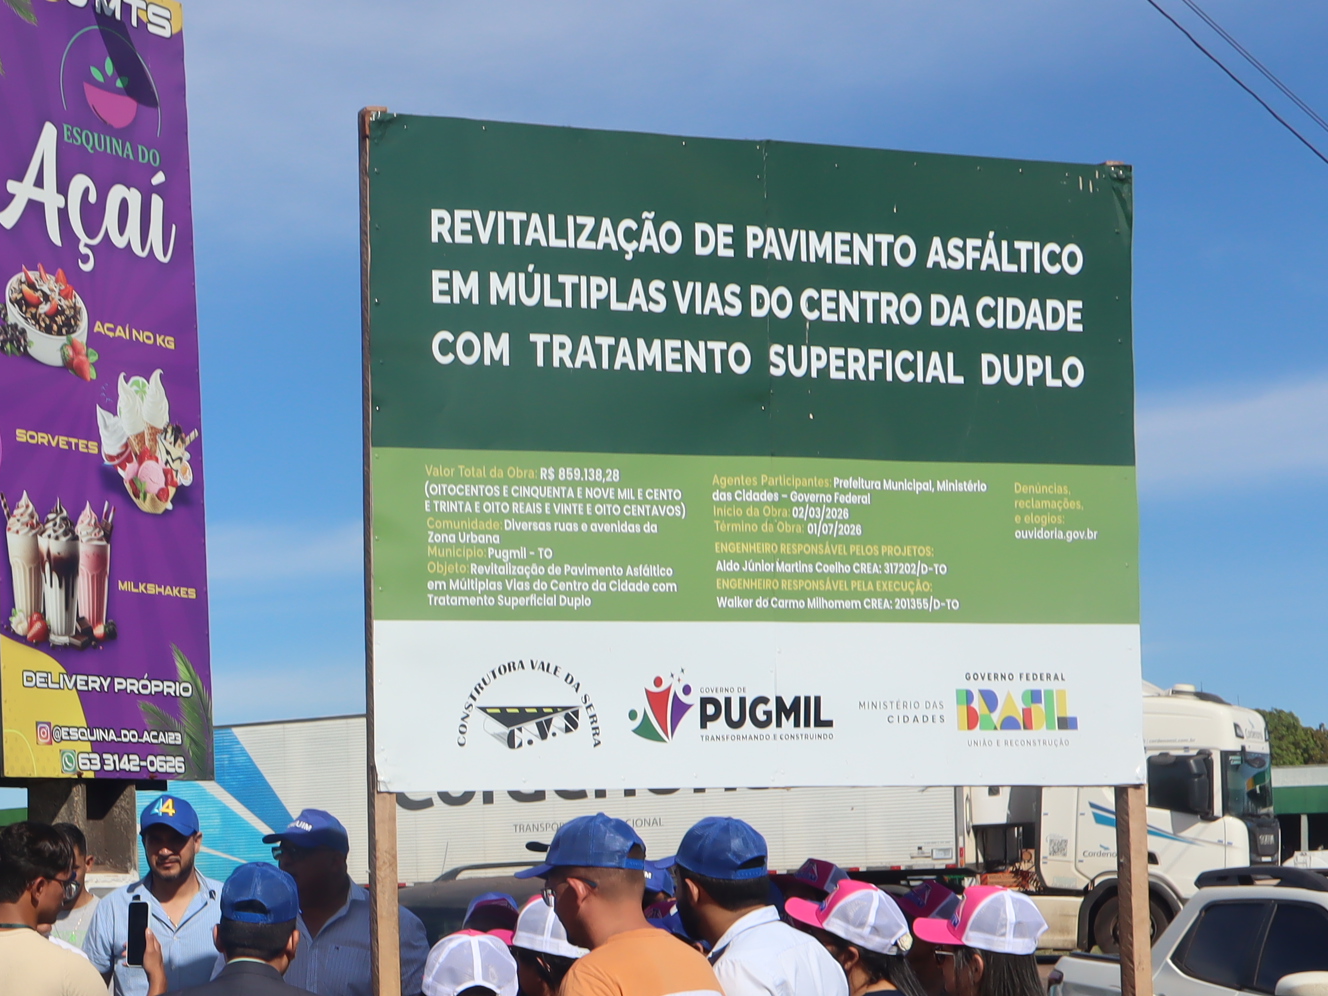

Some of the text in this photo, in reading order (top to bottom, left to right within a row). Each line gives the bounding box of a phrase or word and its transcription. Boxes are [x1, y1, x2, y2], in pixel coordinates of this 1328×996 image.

[68, 0, 171, 38] MTS
[62, 123, 160, 167] ESQUINA DO
[431, 209, 1083, 275] REVITALIZAÇÃO DE PAVIMENTO ASFÁLTICO
[432, 263, 1083, 331] EM MÚLTIPLAS VIAS DO CENTRO DA CIDADE
[93, 321, 175, 349] AÇAÍ NO KG
[432, 331, 1084, 387] COM TRATAMENTO SUPERFICIAL DUPLO
[15, 429, 99, 454] SORVETES
[425, 464, 619, 483] Valor Total da Obra: R$ 859.138,28
[425, 482, 682, 500] (OITOCENTOS E CINQUENTA E NOVE MIL E CENTO
[712, 474, 987, 493] Agentes Participantes: Prefeitura Municipal, Ministério
[1014, 482, 1071, 495] Denúncias,
[712, 489, 870, 504] das Cidades Governo Federal
[1014, 497, 1084, 511] reclamações,
[425, 500, 685, 519] E TRINTA E OITO REAIS E VINTE E OITO CENTAVOS)
[713, 505, 849, 522] Início da Obra: 02/03/2026
[427, 517, 657, 533] Comunidade: Diversas ruas e avenidas da
[1014, 512, 1065, 527] e elogios:
[714, 520, 862, 537] Término da Obra: 01/07/2026
[1014, 526, 1098, 542] ouvidoria.gov.br
[428, 531, 500, 544] Zona Urbana
[428, 545, 553, 562] Município: Pugmil TO
[715, 541, 934, 557] ENGENHEIRO RESPONSÁVEL PELOS PROJETOS:
[427, 561, 673, 578] Objeto: Revitalização de Pavimento Asfáltico
[716, 560, 740, 571] Aldo
[742, 559, 774, 572] Júnior
[776, 560, 813, 573] Martins
[815, 562, 851, 573] Coelho
[853, 562, 882, 574] CREA:
[118, 580, 196, 599] MILKSHAKES
[427, 578, 677, 594] em Múltiplas Vias do Centro da Cidade com
[716, 577, 932, 595] ENGENHEIRO RESPONSÁVEL PELA EXECUÇÃO:
[427, 594, 591, 610] Tratamento Superficial Duplo
[716, 596, 753, 608] Walker
[755, 596, 769, 608] do
[771, 597, 805, 609] Carmo
[807, 597, 861, 609] Milhomem
[863, 598, 893, 609] CREA:
[23, 670, 193, 697] DELIVERY PRÓPRIO
[965, 672, 1065, 681] GOVERNO FEDERAL
[456, 658, 602, 748] CONSTRUTORA VALE DA SERRA
[858, 698, 944, 710] MINISTÉRIO DAS
[956, 689, 1078, 730] BRASIL
[700, 696, 833, 729] PUGMIL
[887, 715, 945, 723] CIDADES
[967, 738, 1069, 748] UNIÃO E RECONSTRUÇÃO
[78, 753, 185, 773] 63 3142-0626
[513, 817, 665, 833] TRANSPO CIONAL
[1082, 850, 1117, 858] Cordeno
